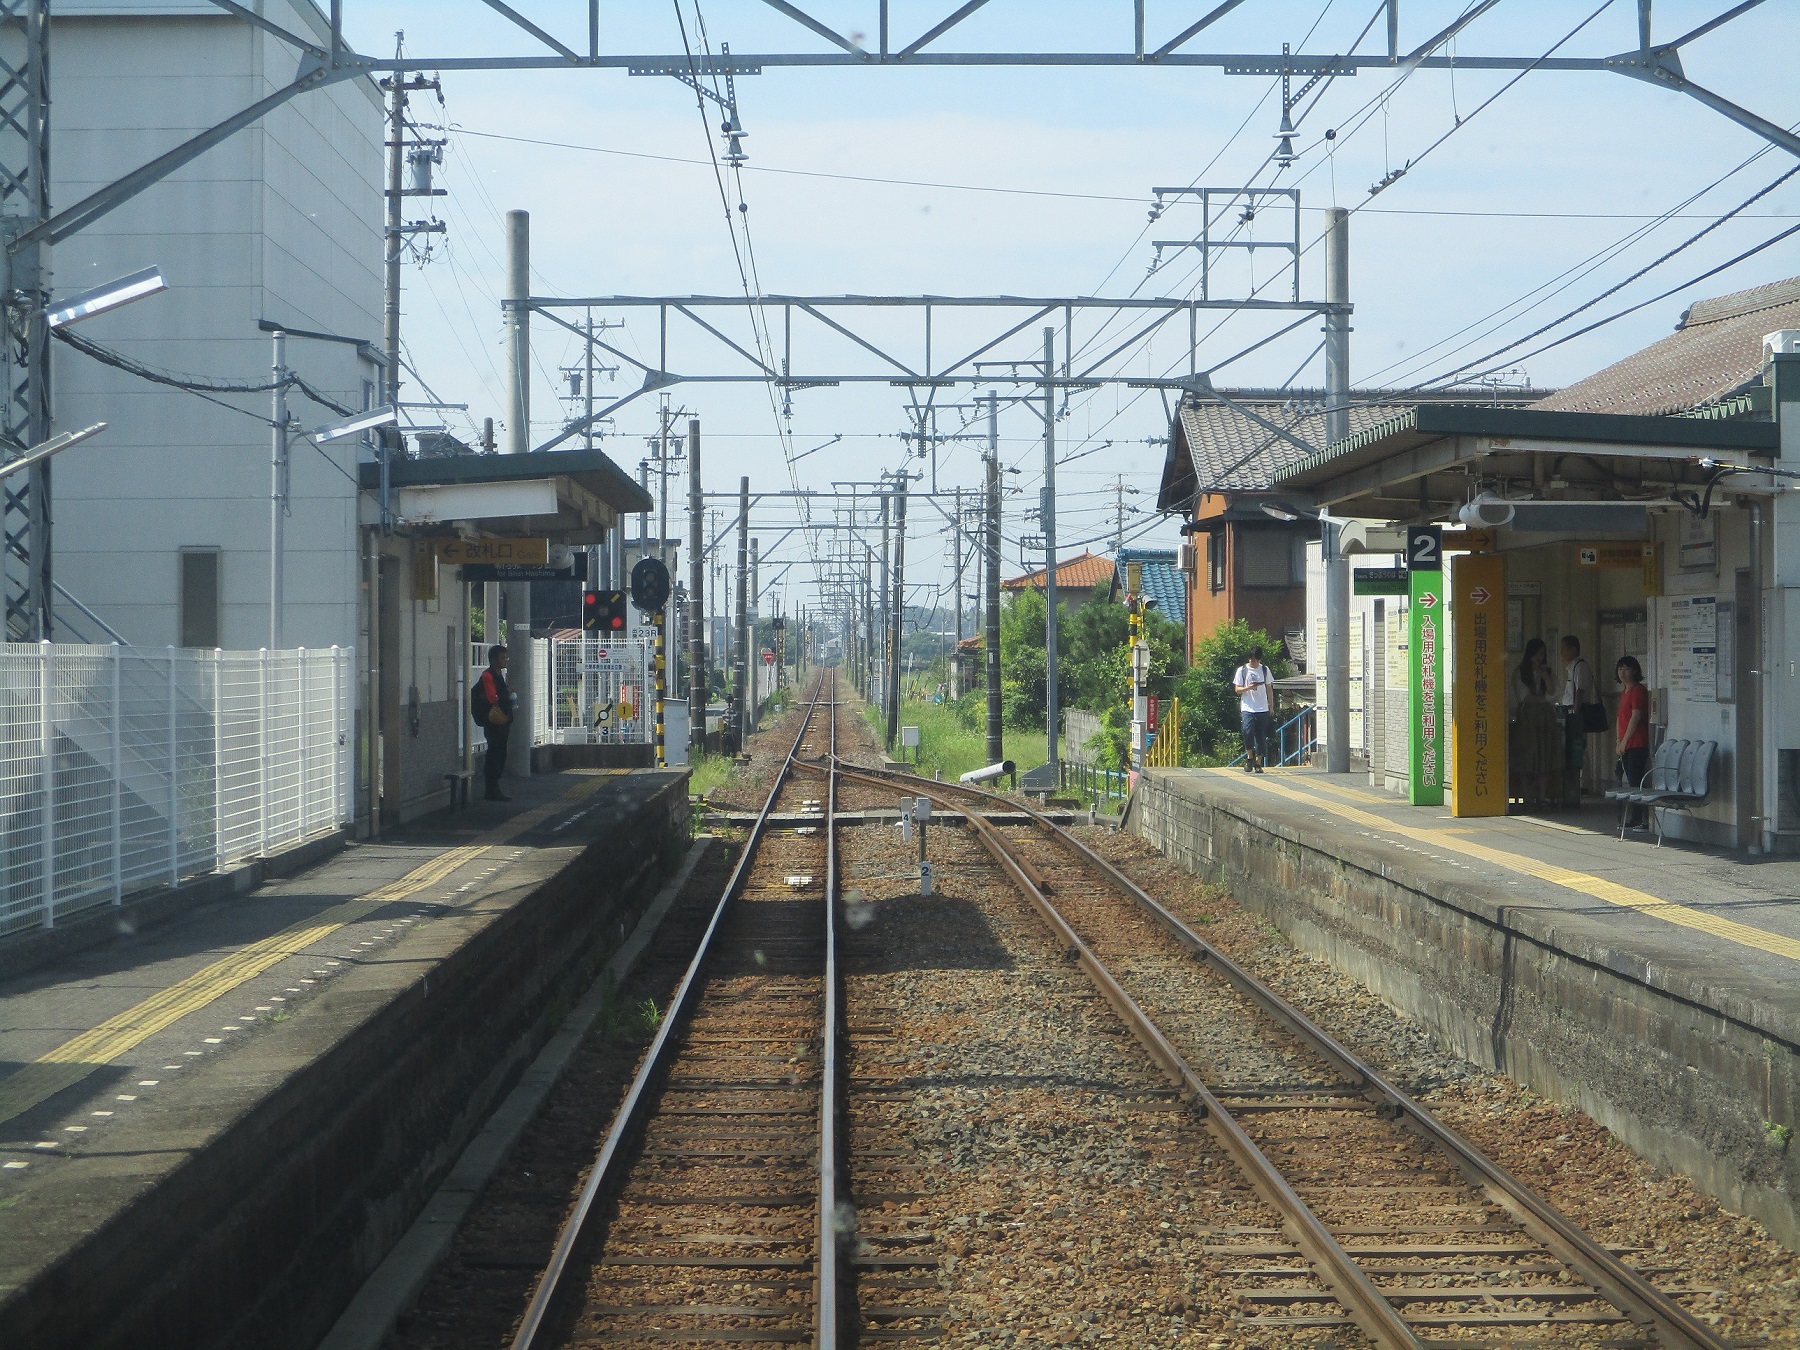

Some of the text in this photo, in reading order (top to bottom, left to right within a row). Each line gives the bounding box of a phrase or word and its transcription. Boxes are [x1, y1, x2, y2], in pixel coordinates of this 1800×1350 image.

[465, 543, 513, 559] 改札口
[1413, 534, 1436, 562] 2
[1421, 615, 1436, 787] 入場用改札機をご利用ください
[1474, 612, 1488, 797] 出場用改札機をご利用ください
[622, 706, 626, 715] 1
[602, 726, 609, 735] 3
[903, 813, 909, 822] 4
[921, 866, 929, 876] 2
